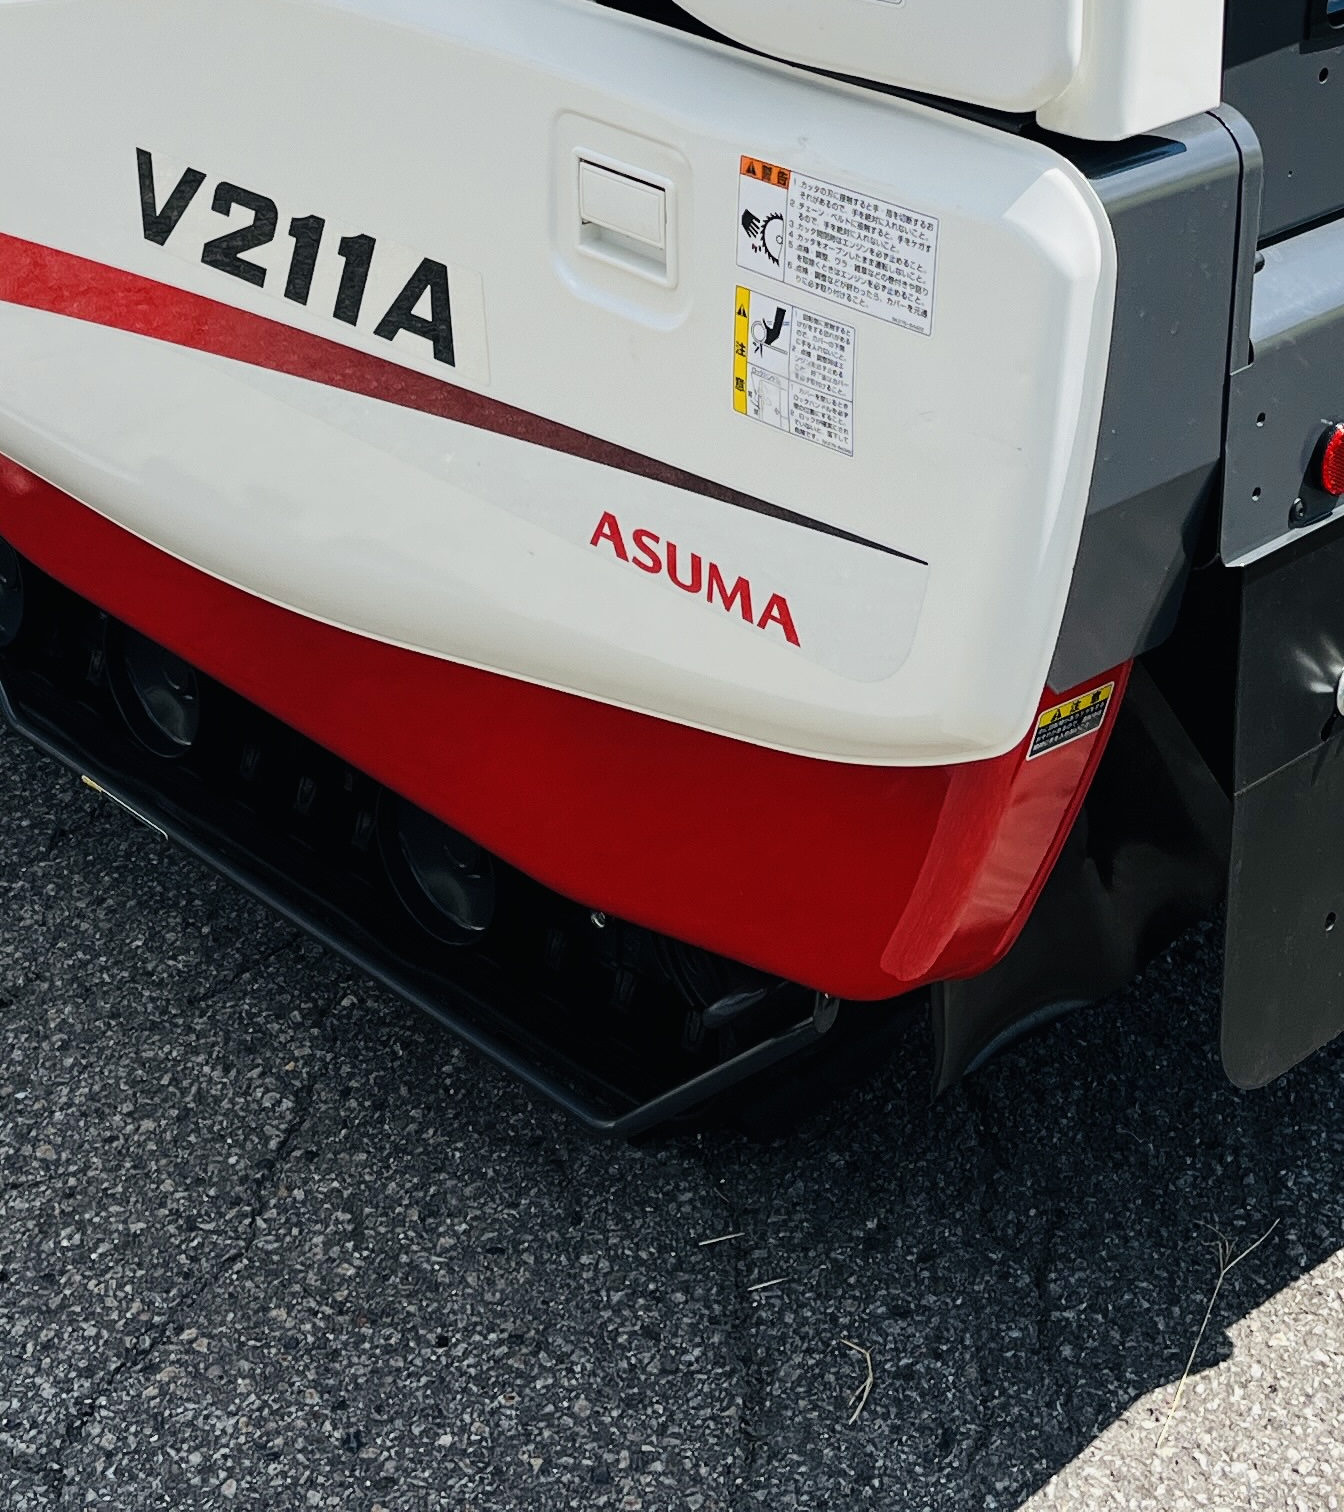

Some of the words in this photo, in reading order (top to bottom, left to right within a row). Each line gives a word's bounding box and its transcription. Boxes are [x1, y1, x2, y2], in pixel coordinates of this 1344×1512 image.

[762, 165, 788, 187] 警告
[137, 147, 456, 366] V211A
[592, 513, 799, 645] ASUMA
